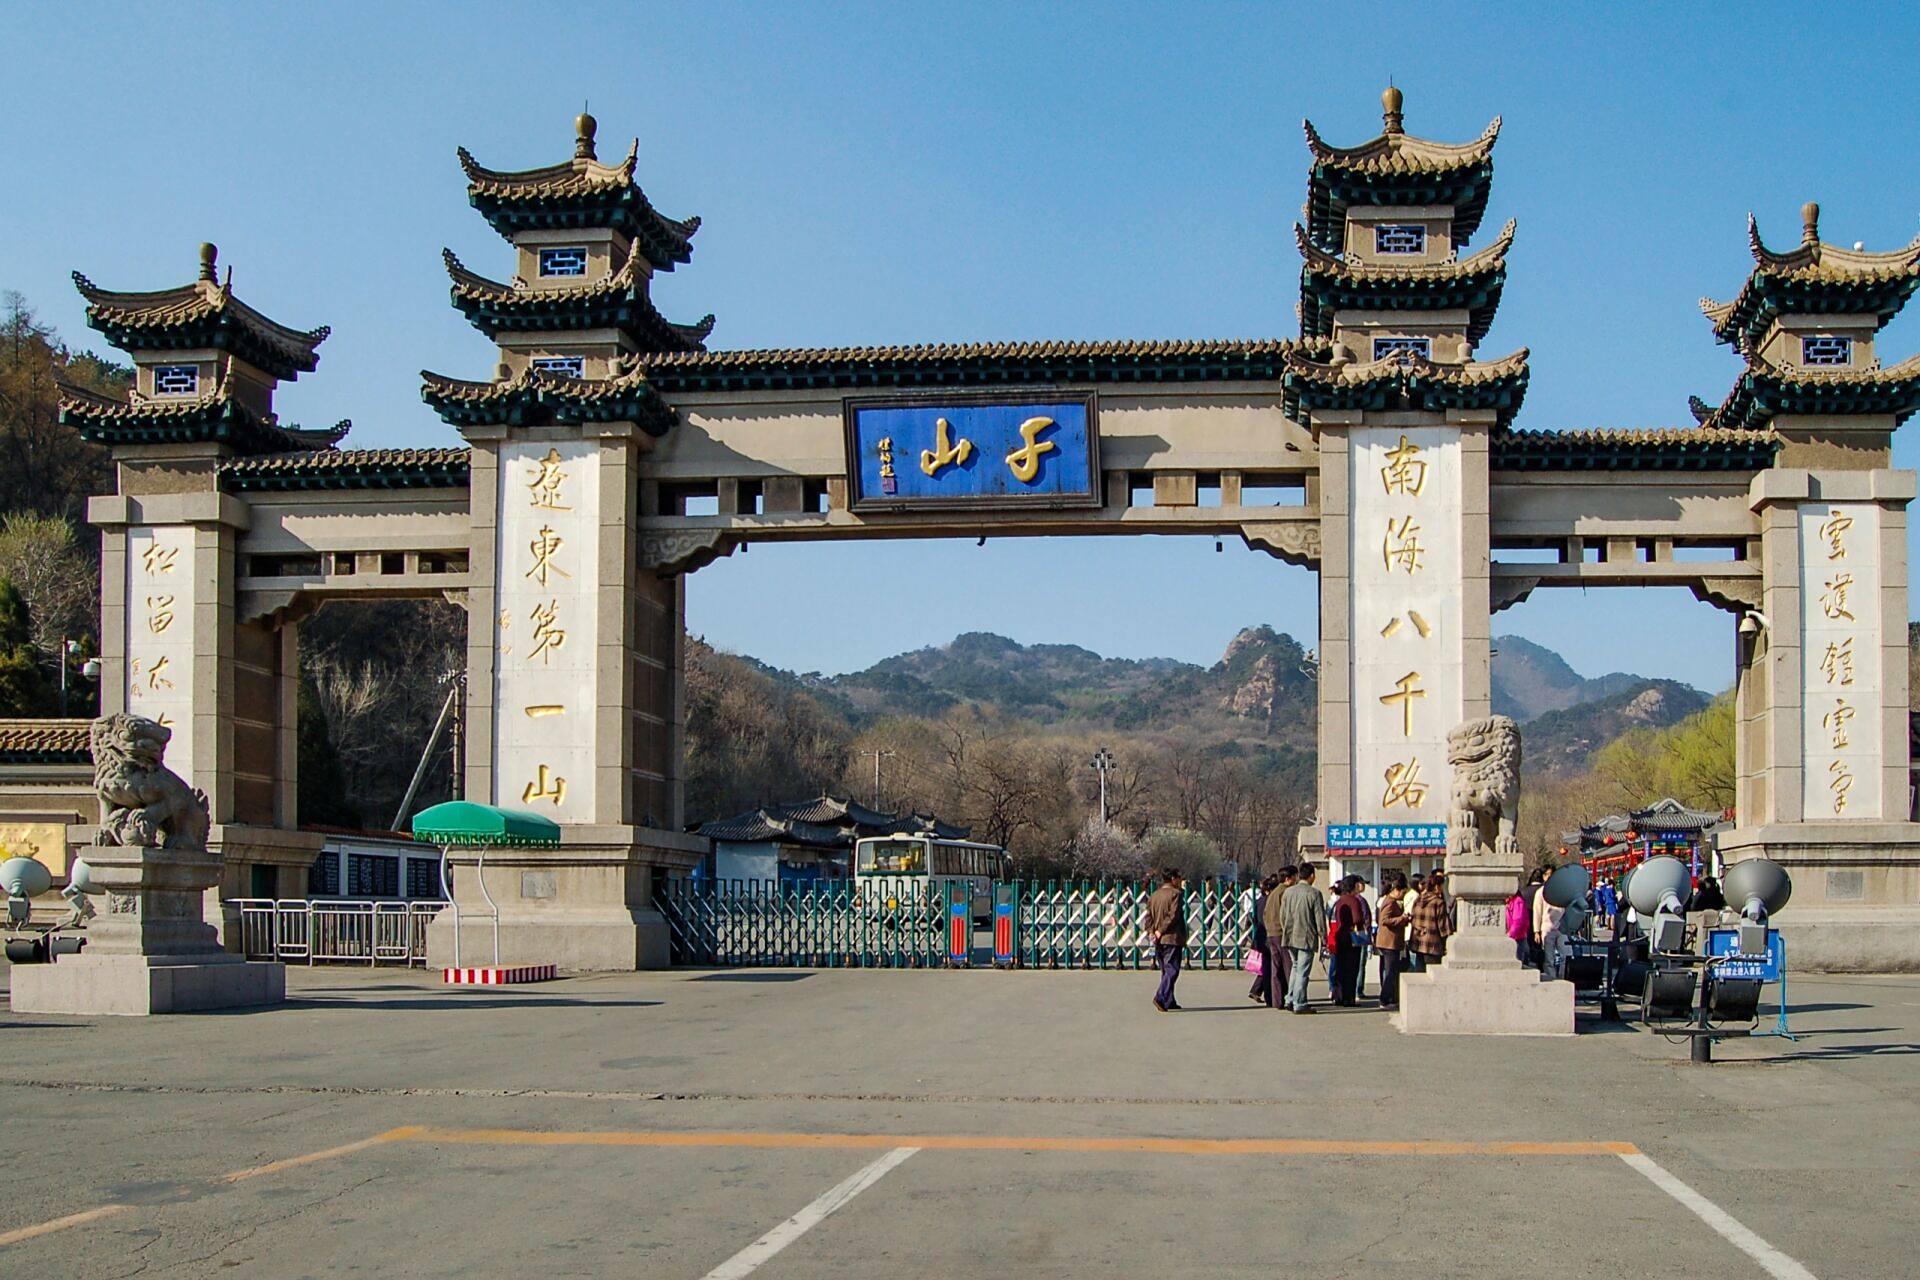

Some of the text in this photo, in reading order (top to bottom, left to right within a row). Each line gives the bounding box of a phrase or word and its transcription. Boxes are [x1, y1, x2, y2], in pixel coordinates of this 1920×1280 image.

[521, 447, 574, 807] 遼東第一山
[1379, 434, 1432, 809] 南海八千路
